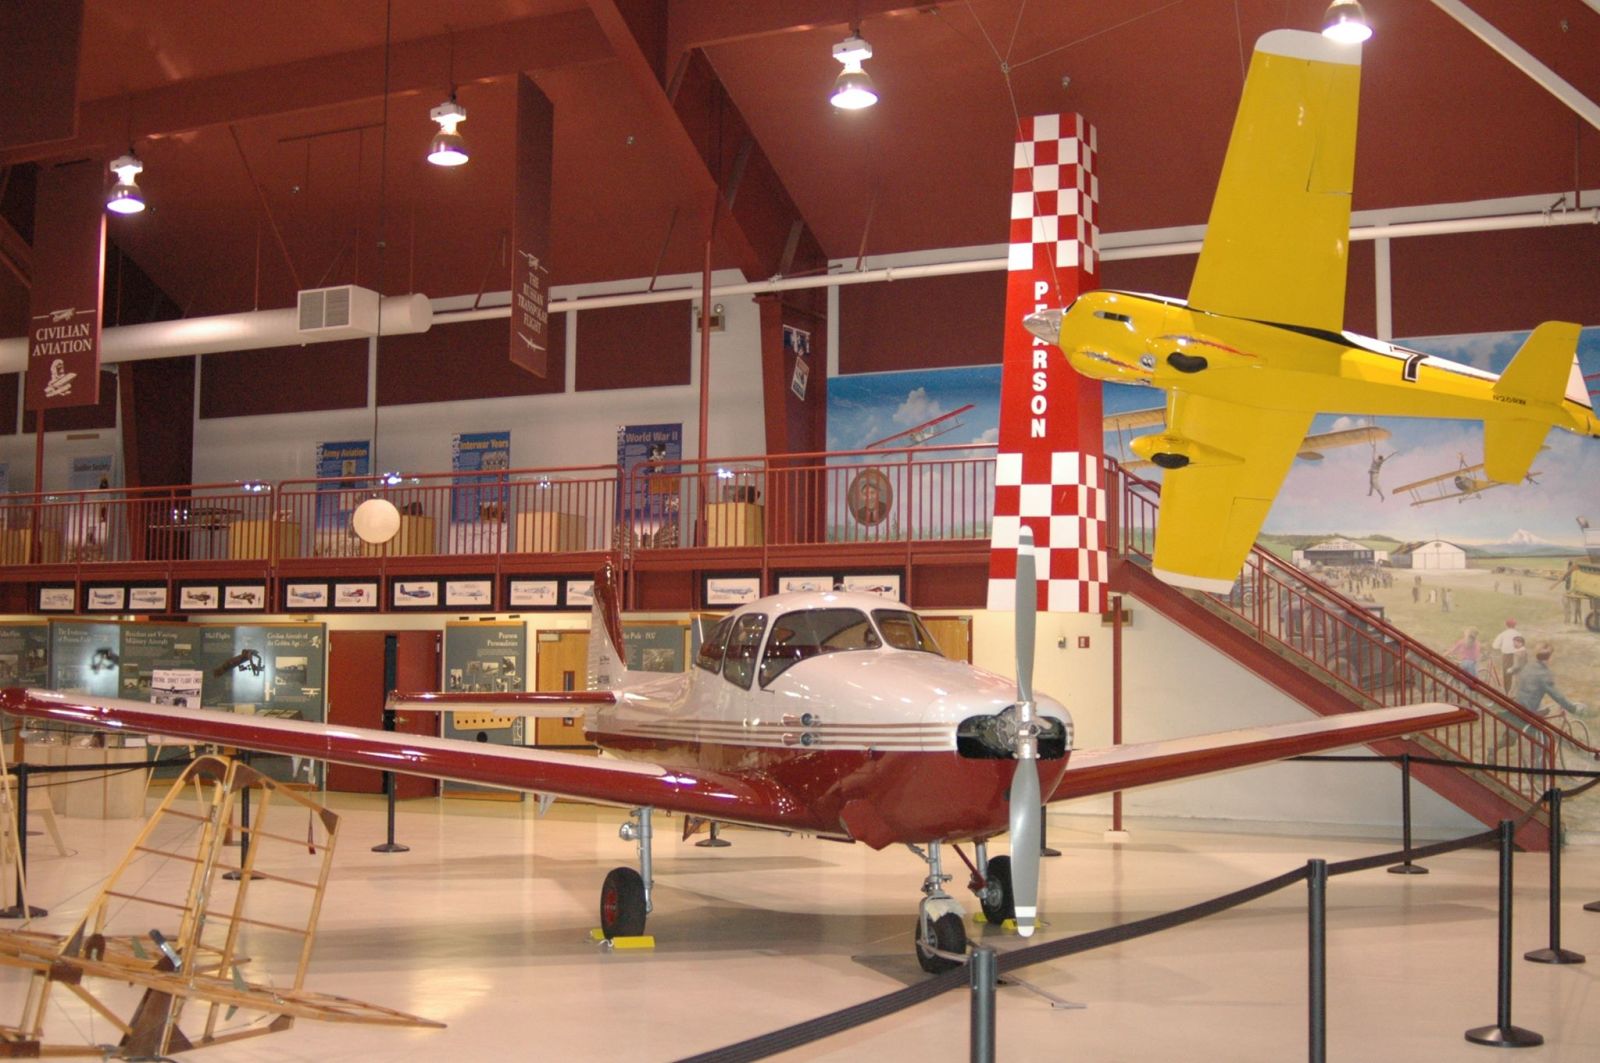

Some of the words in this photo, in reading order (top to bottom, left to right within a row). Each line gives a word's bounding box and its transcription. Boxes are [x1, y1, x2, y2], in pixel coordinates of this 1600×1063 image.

[35, 322, 91, 342] CIVILIAN
[32, 338, 93, 357] AVIATION
[625, 431, 652, 443] World
[653, 431, 671, 442] War
[672, 430, 678, 440] II
[341, 447, 368, 458] Aviation
